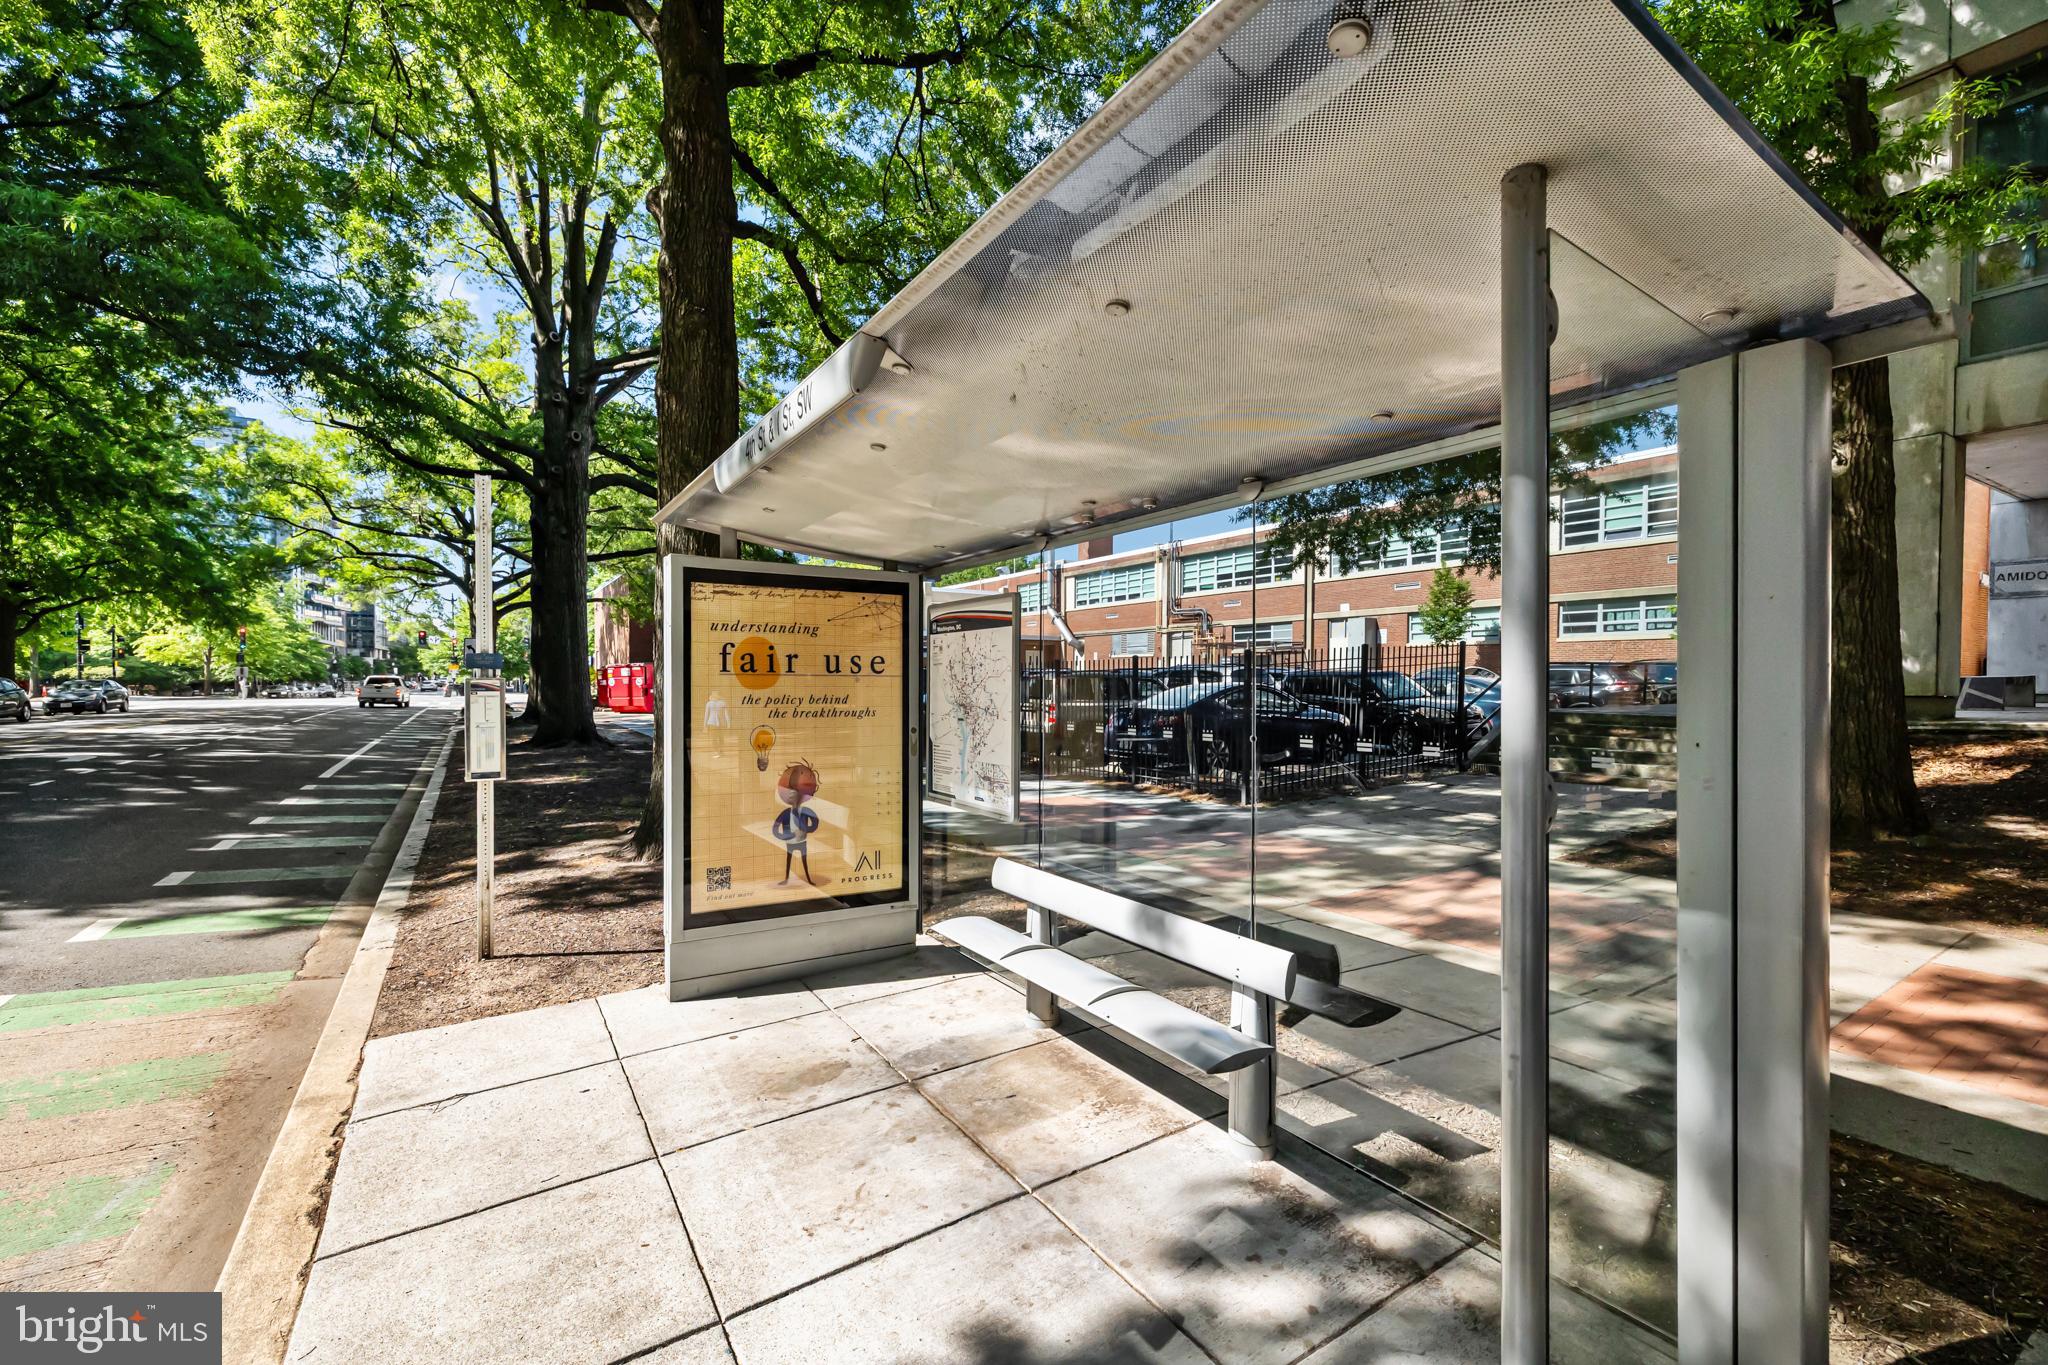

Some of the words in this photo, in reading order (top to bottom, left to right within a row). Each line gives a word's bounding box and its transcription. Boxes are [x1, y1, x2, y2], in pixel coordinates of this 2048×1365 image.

[746, 435, 756, 460] 4th
[758, 426, 766, 451] St
[768, 417, 775, 443] &
[782, 403, 794, 430] St,
[797, 381, 813, 419] SW
[710, 619, 820, 637] understanding
[719, 642, 799, 673] fair
[824, 653, 886, 675] use
[741, 693, 761, 705] the
[765, 694, 804, 708] policy
[808, 693, 849, 705] behind
[768, 708, 787, 719] the
[792, 707, 877, 719] breakthroughs
[841, 872, 894, 884] PROGRESS
[706, 893, 723, 902] Find
[724, 892, 736, 900] out
